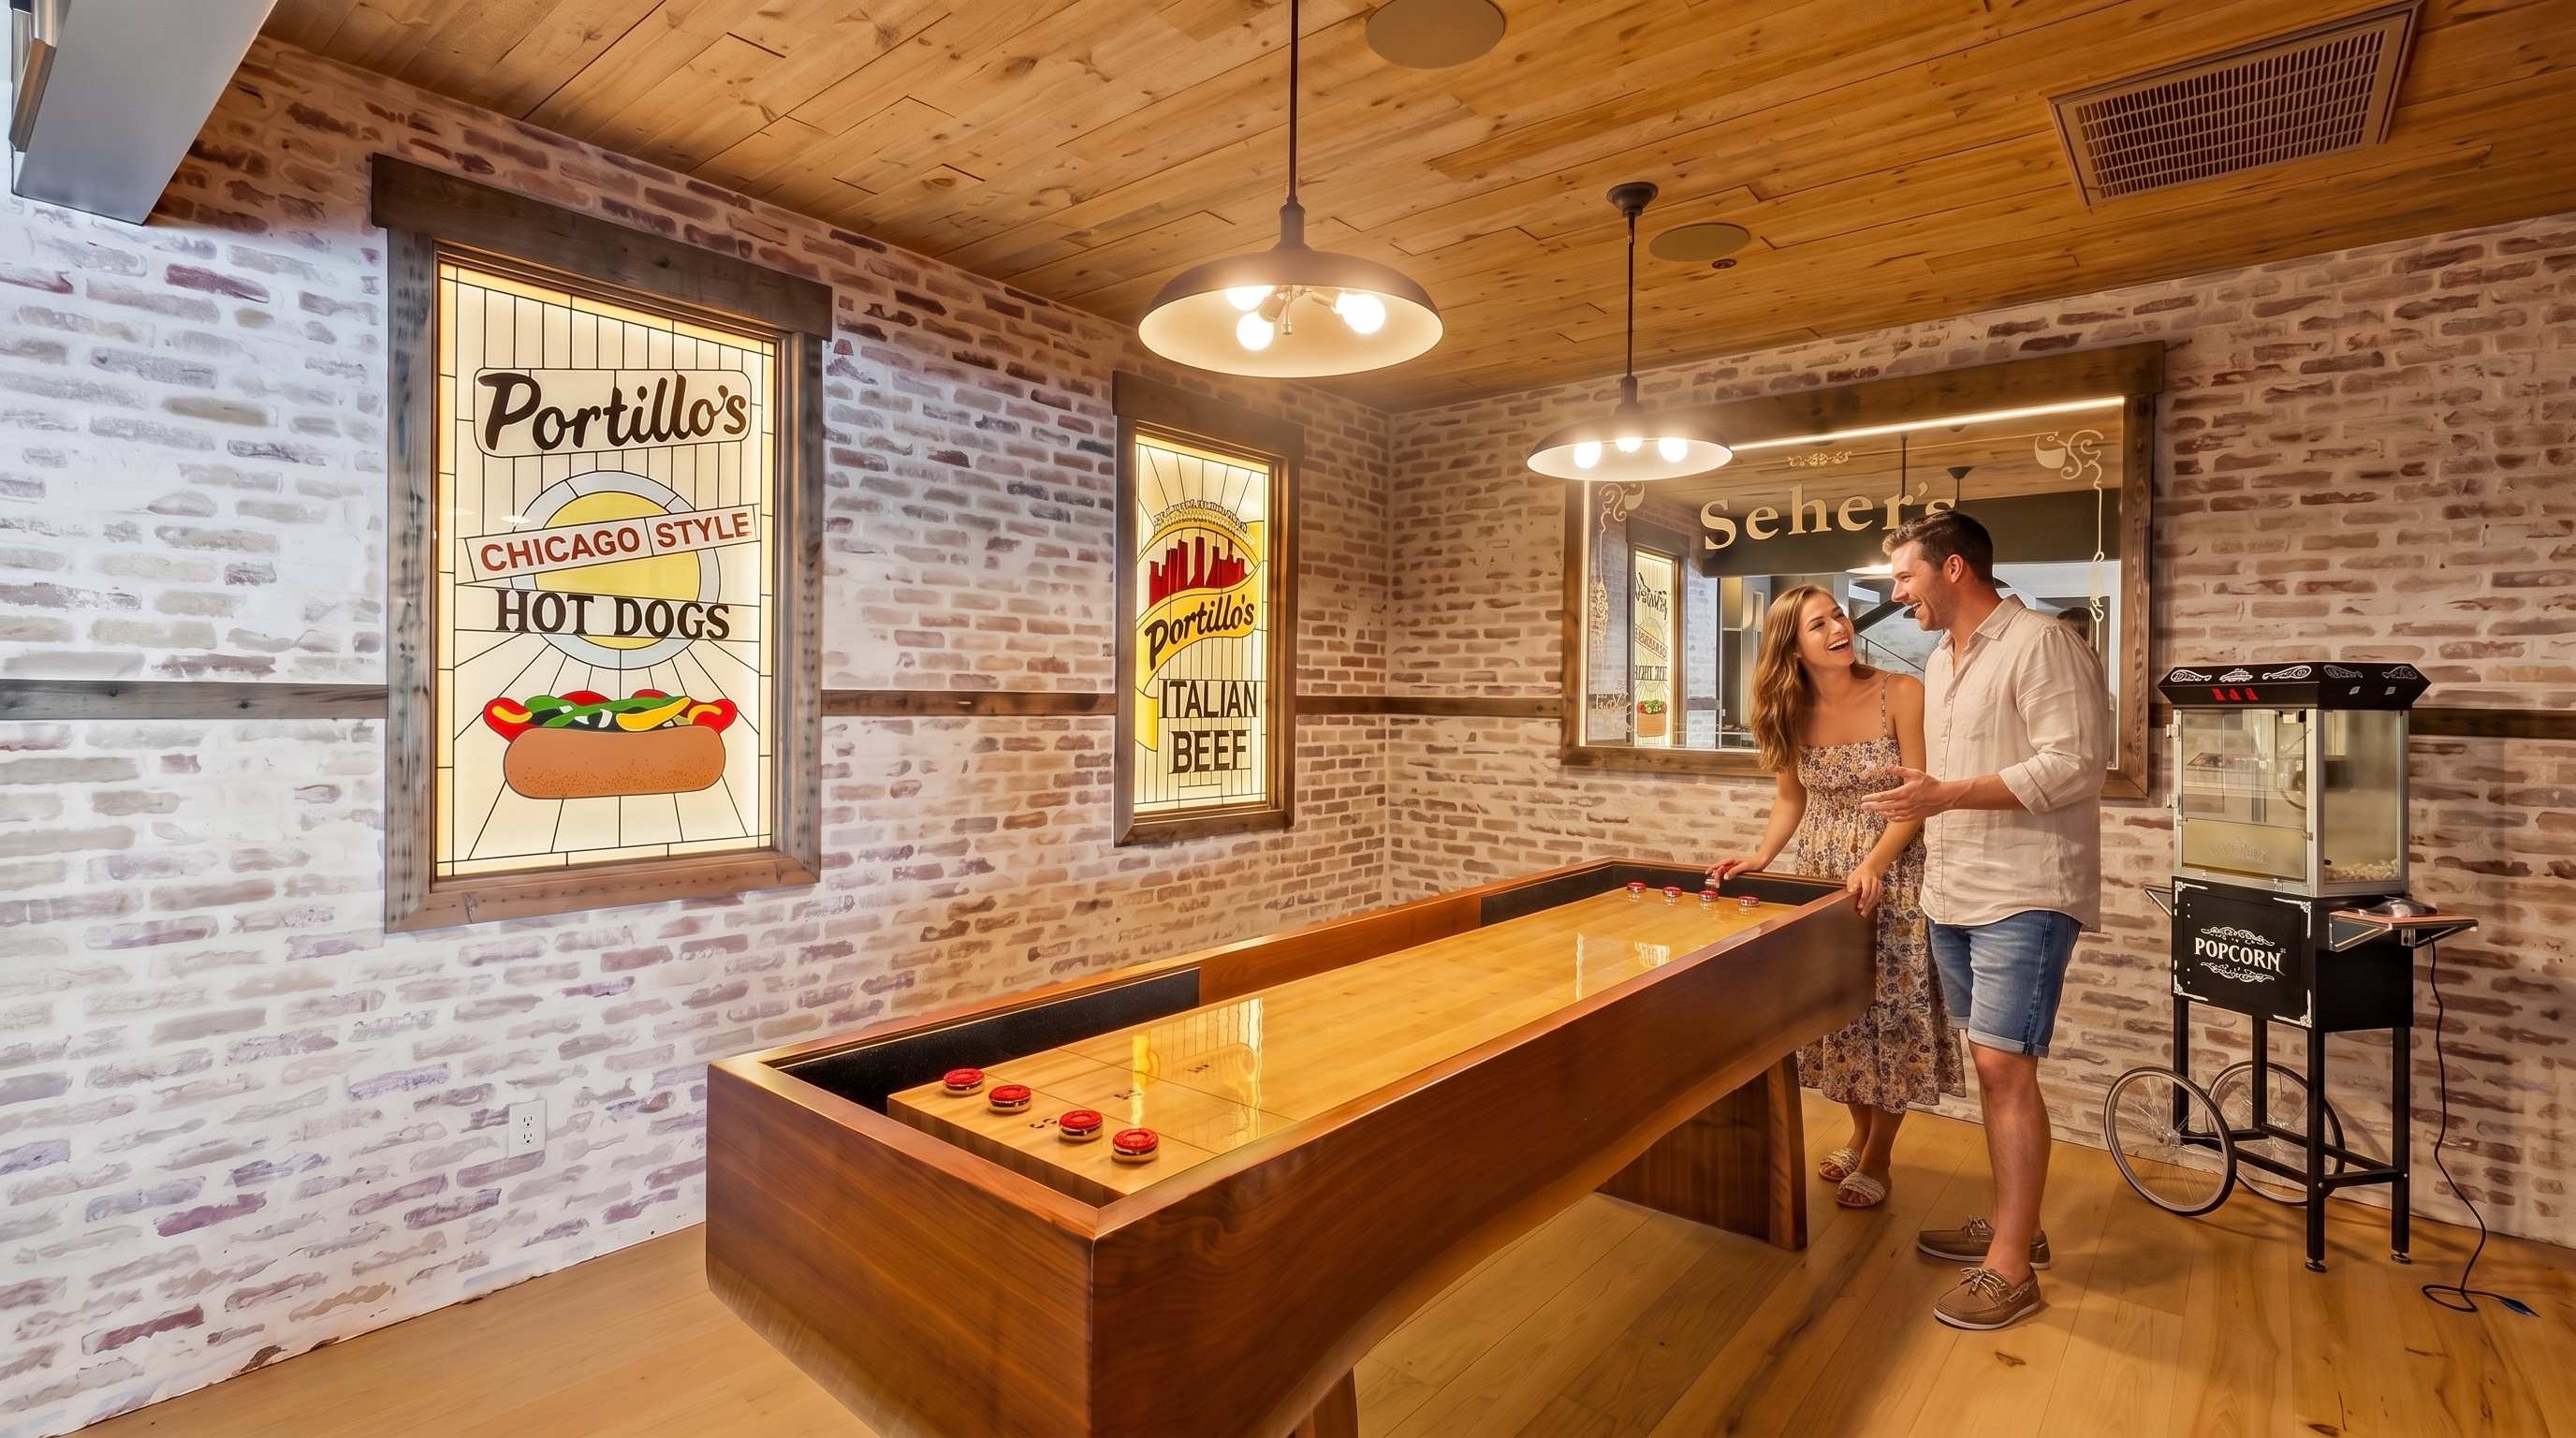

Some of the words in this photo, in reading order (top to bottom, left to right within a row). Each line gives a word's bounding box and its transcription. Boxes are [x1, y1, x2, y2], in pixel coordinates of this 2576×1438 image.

[478, 373, 747, 450] Portillo's
[481, 527, 640, 571] CHICAGO
[656, 513, 750, 549] STYLE
[496, 590, 594, 635] HOT
[615, 597, 730, 639] DOGS
[1145, 594, 1254, 670] Portillo's
[1163, 680, 1257, 718] ITALIAN
[1171, 729, 1247, 774] BEEF
[2194, 938, 2285, 976] POPCORN
